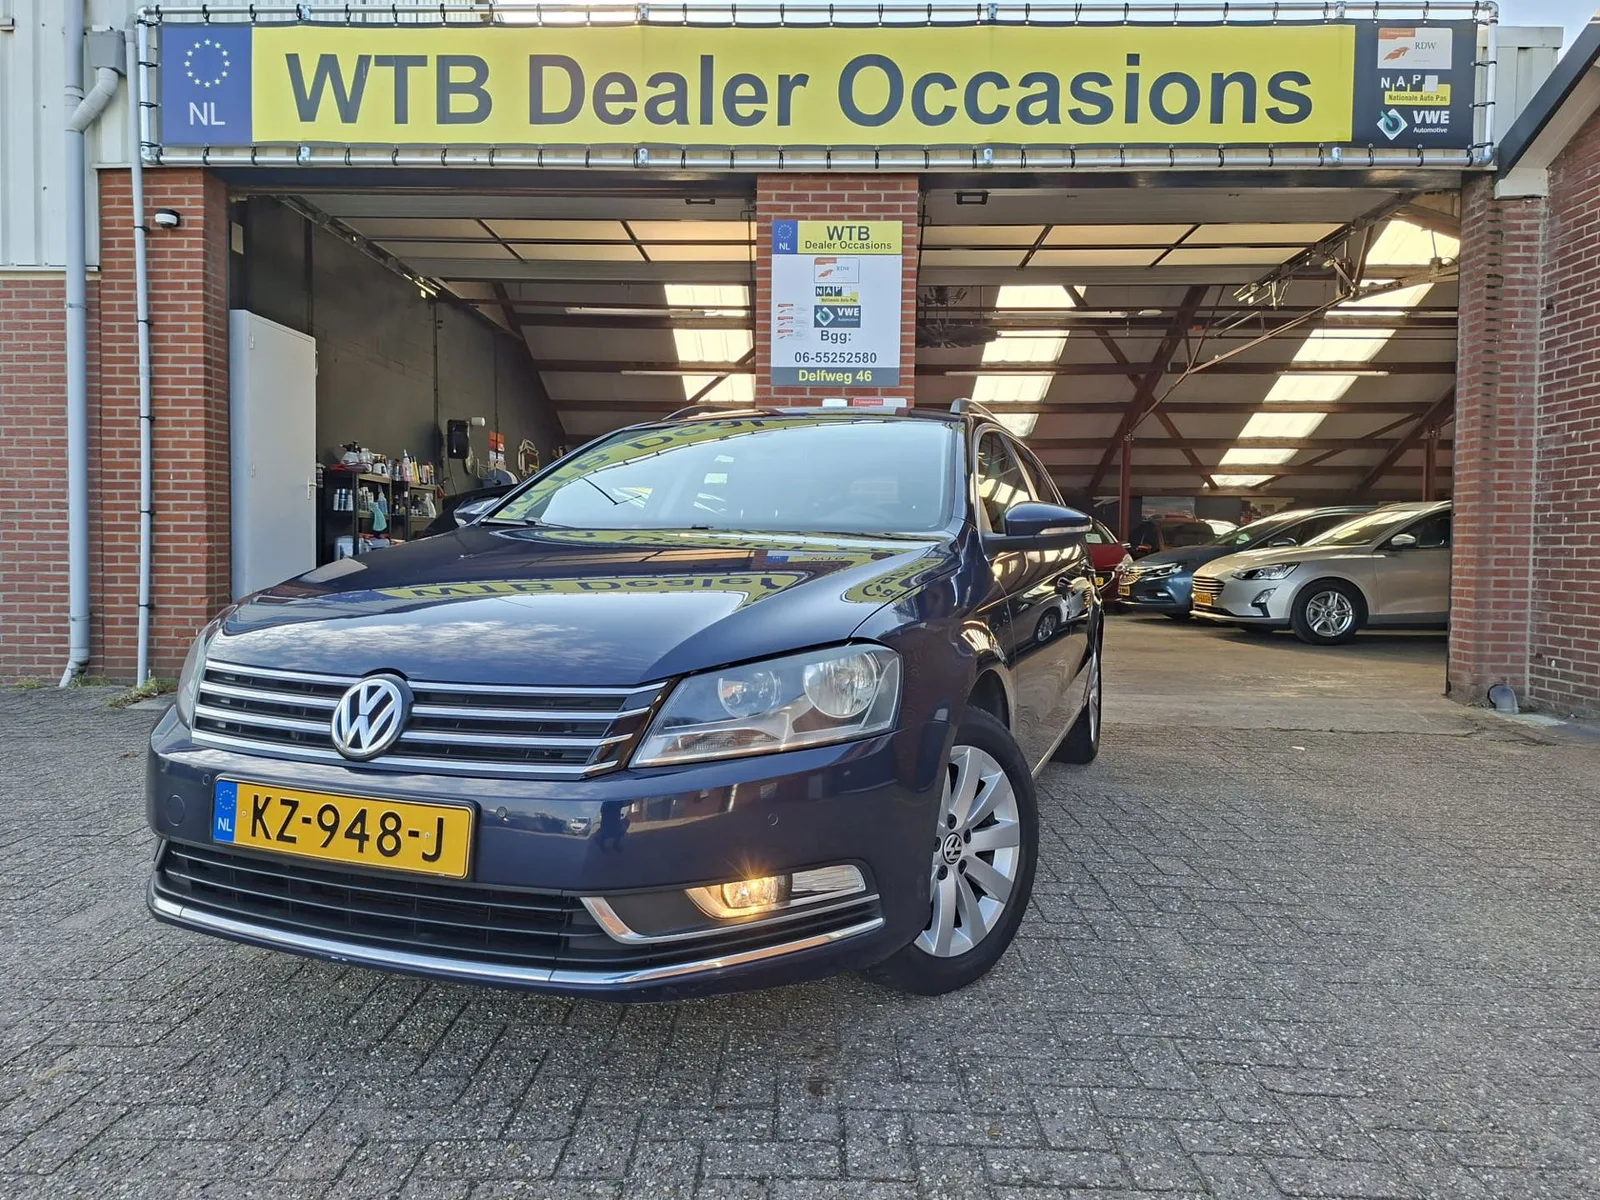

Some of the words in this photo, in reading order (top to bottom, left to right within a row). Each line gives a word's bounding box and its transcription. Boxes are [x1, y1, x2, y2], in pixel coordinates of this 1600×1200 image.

[1415, 42, 1436, 50] RDW
[285, 53, 493, 125] WTB
[529, 53, 809, 126] Dealer
[838, 53, 1312, 127] Occasions
[1388, 94, 1418, 102] Nationale
[1420, 94, 1434, 102] Auto
[1436, 94, 1447, 102] Pas
[189, 102, 225, 126] NL
[1413, 110, 1450, 124] VWE
[826, 225, 870, 241] WTB
[779, 242, 790, 251] NL
[805, 241, 836, 250] Dealer
[839, 241, 892, 250] Occasions
[837, 308, 859, 316] VWE
[820, 330, 851, 344] Bgg:
[794, 352, 877, 363] 06-55252580
[798, 370, 852, 384] Delfweg
[856, 370, 872, 381] 46
[217, 816, 233, 832] NL
[250, 793, 445, 864] KZ-948-J
